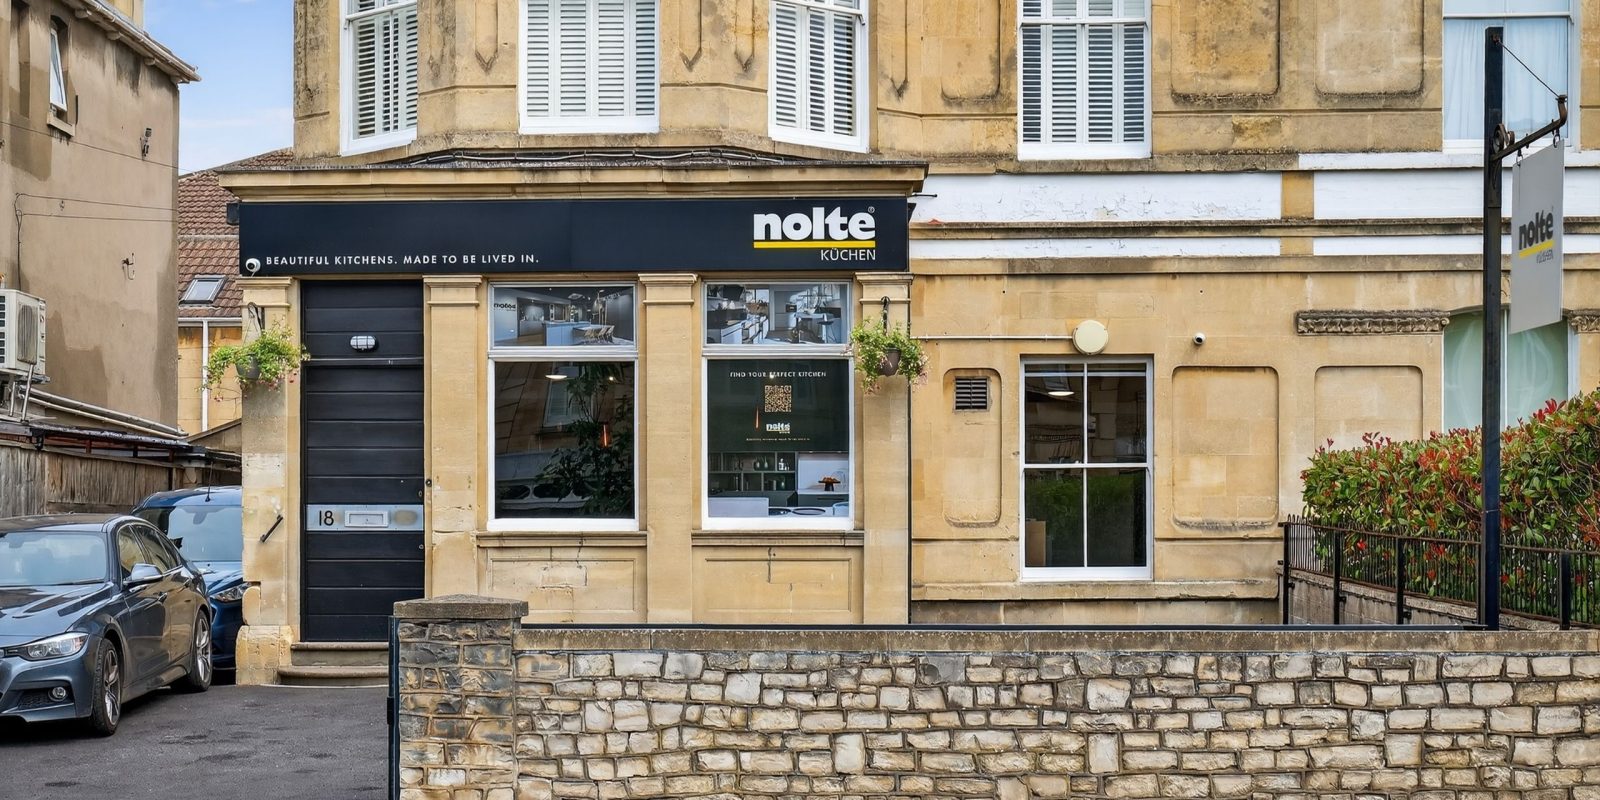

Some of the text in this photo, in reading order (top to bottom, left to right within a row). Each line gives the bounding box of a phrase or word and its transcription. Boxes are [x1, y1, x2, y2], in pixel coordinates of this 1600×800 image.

[1519, 210, 1553, 250] nolte
[266, 254, 539, 266] BEAUTIFUL KITCHENS. MADE TO BE LIVED IN.
[820, 247, 876, 261] KÜCHEN
[319, 510, 334, 526] 18
